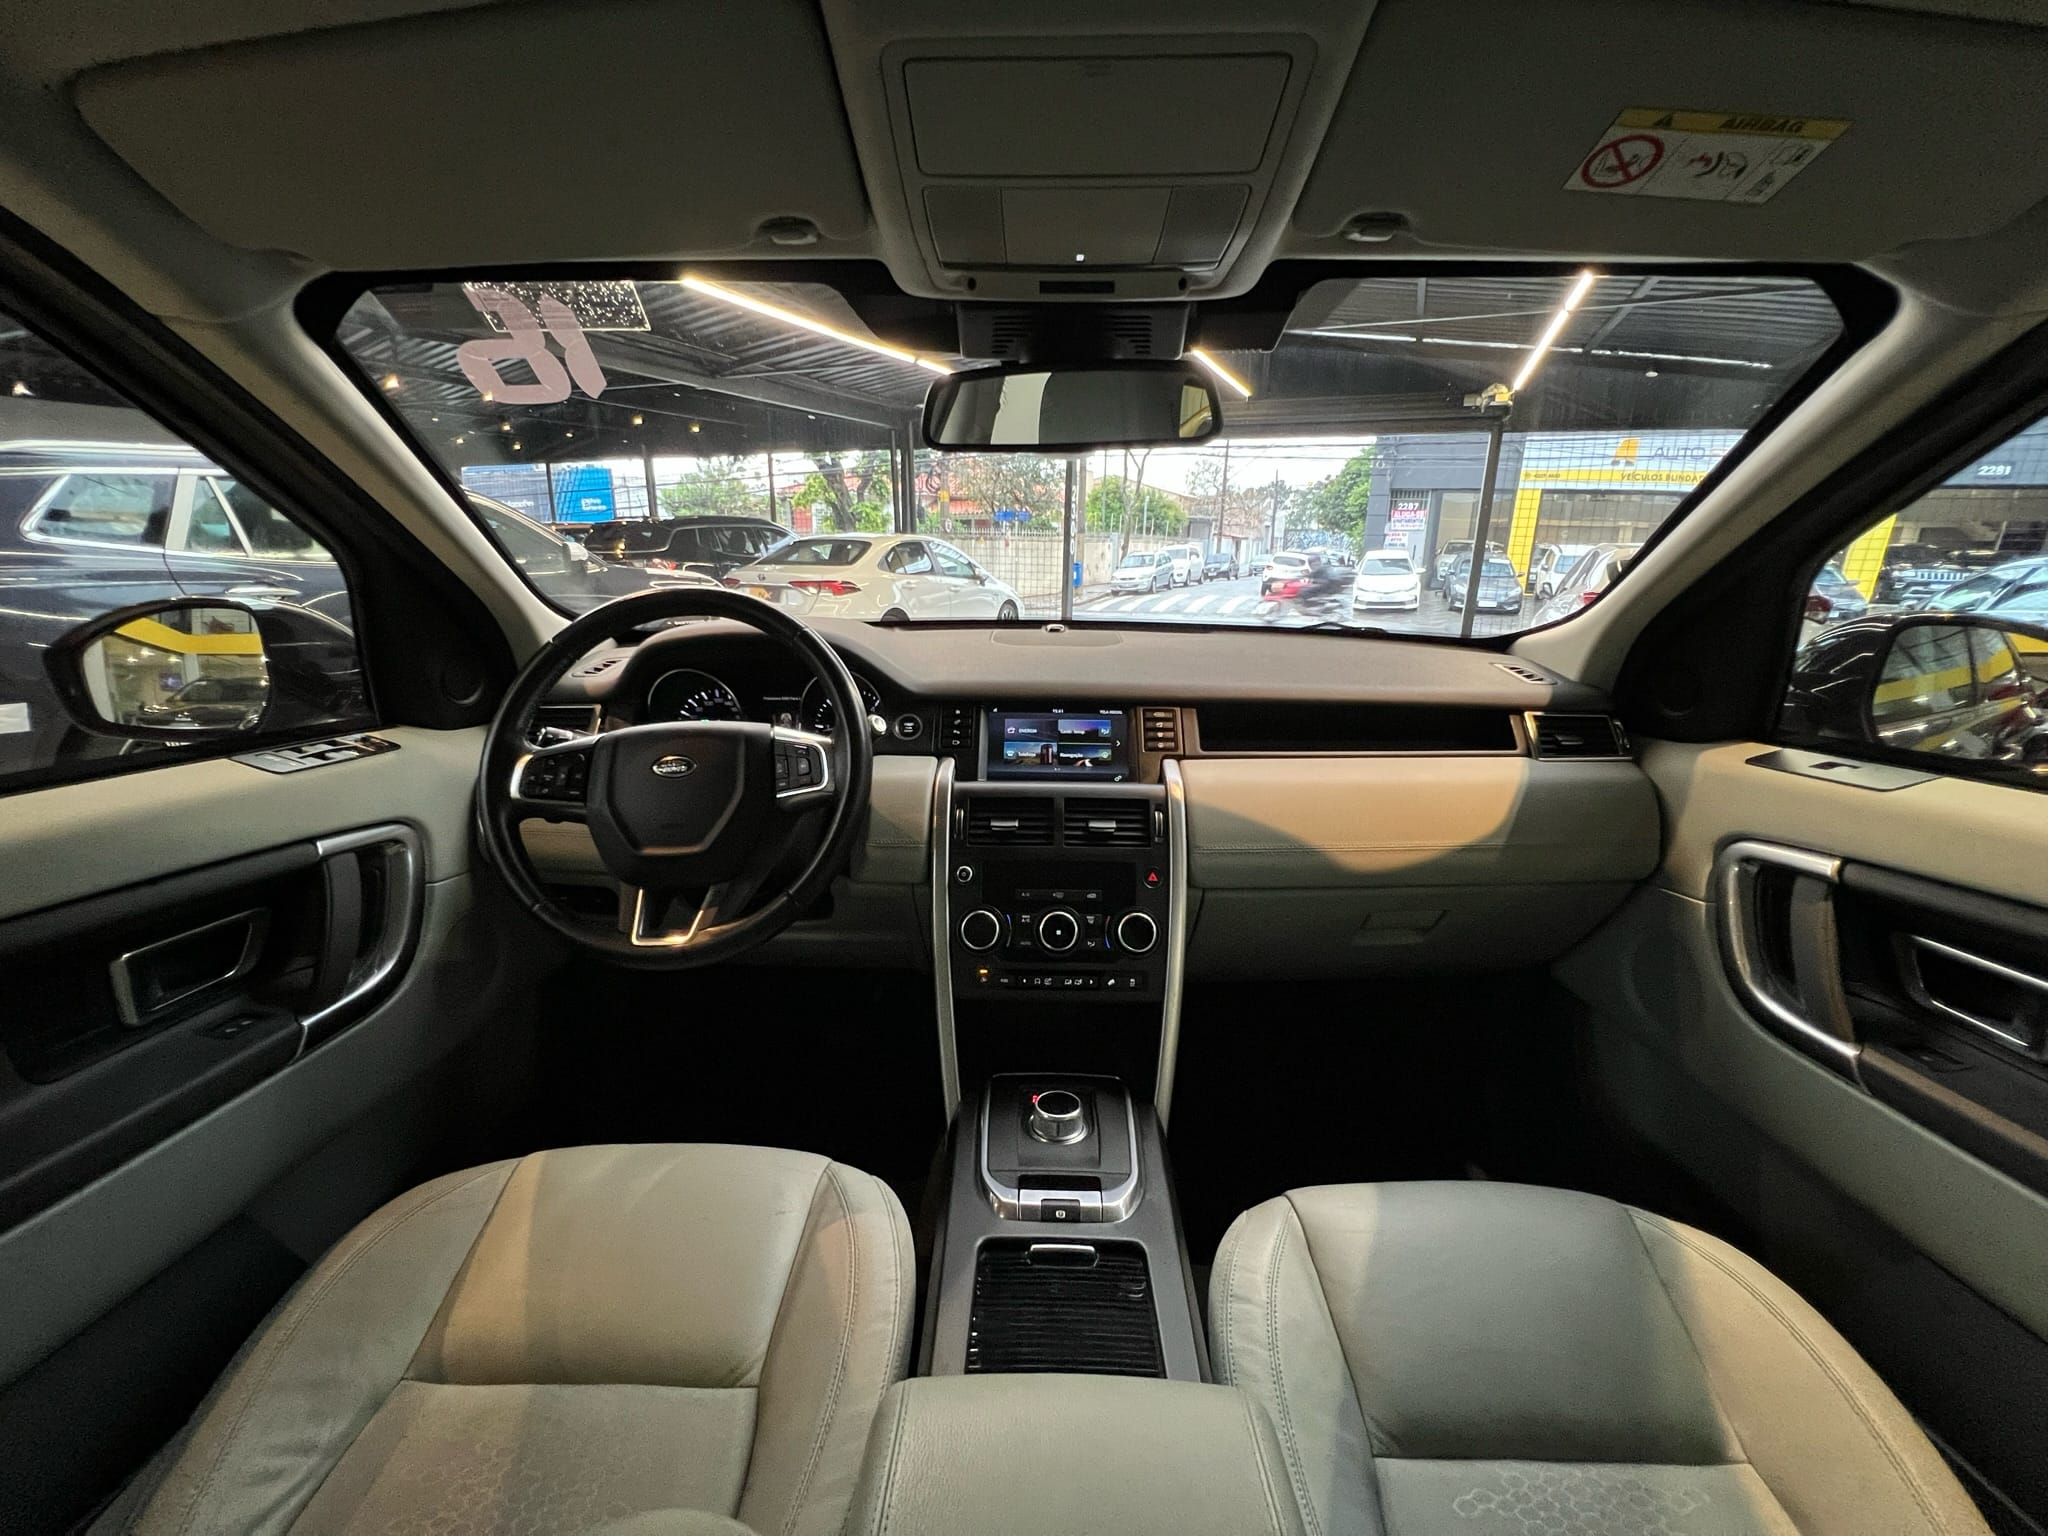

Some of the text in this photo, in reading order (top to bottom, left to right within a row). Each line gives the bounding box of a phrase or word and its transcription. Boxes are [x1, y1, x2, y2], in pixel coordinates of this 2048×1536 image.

[1718, 116, 1806, 133] AIRBAG
[1653, 447, 1705, 460] AUTO
[1397, 502, 1419, 511] 2287
[1069, 485, 1077, 555] 2300
